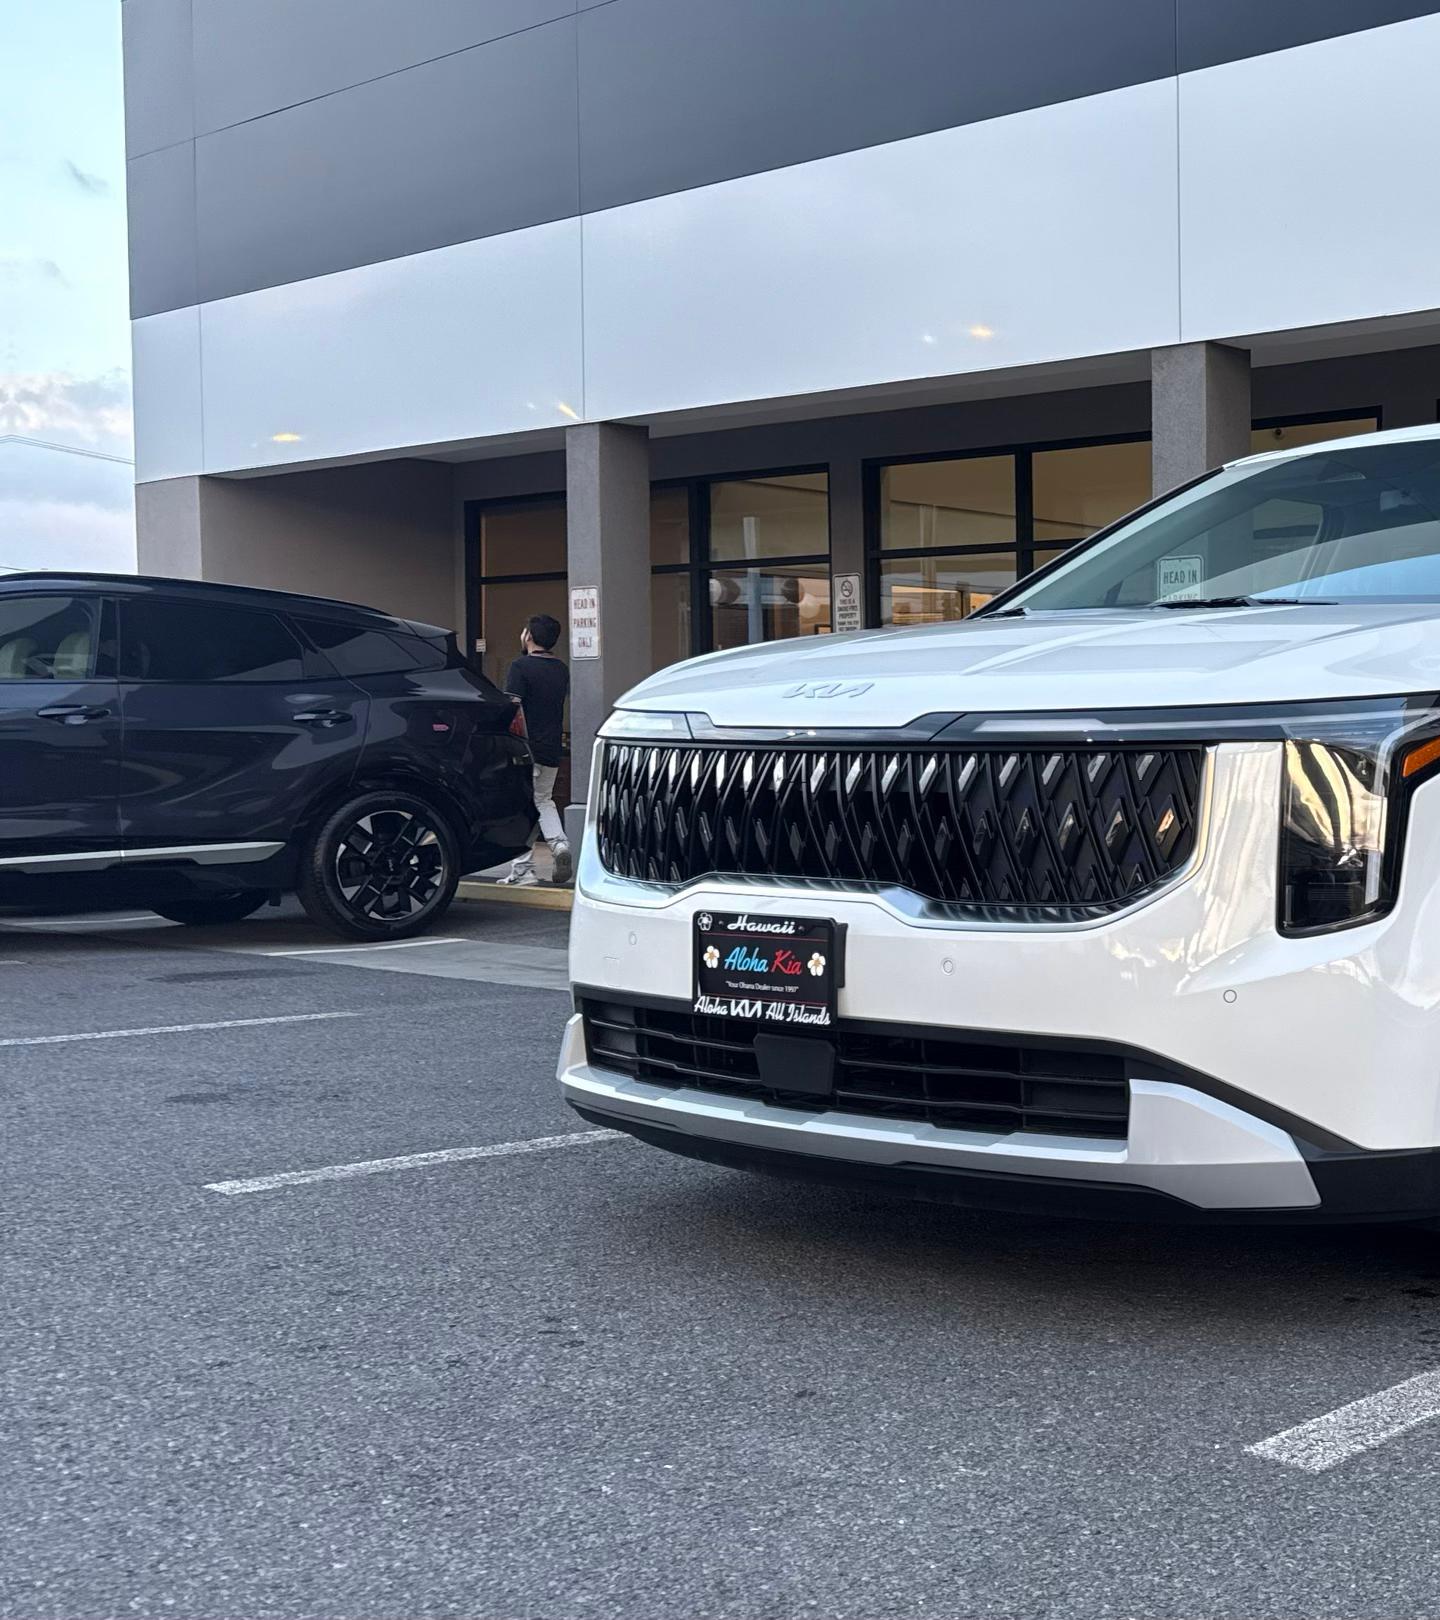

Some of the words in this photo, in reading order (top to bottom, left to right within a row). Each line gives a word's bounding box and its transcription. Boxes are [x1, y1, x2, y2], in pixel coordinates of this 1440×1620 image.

[1163, 570, 1185, 584] HEAD
[1188, 569, 1197, 584] IN
[574, 598, 587, 609] HEAD
[589, 598, 595, 608] IN
[573, 617, 597, 628] PARKING
[782, 682, 876, 699] KIA
[727, 914, 796, 934] Hawaii
[724, 946, 768, 973] Aloha
[771, 949, 802, 976] Kia
[694, 995, 728, 1015] Aloha
[731, 999, 762, 1018] KIA
[765, 1002, 786, 1020] All
[786, 1003, 831, 1025] Islands
